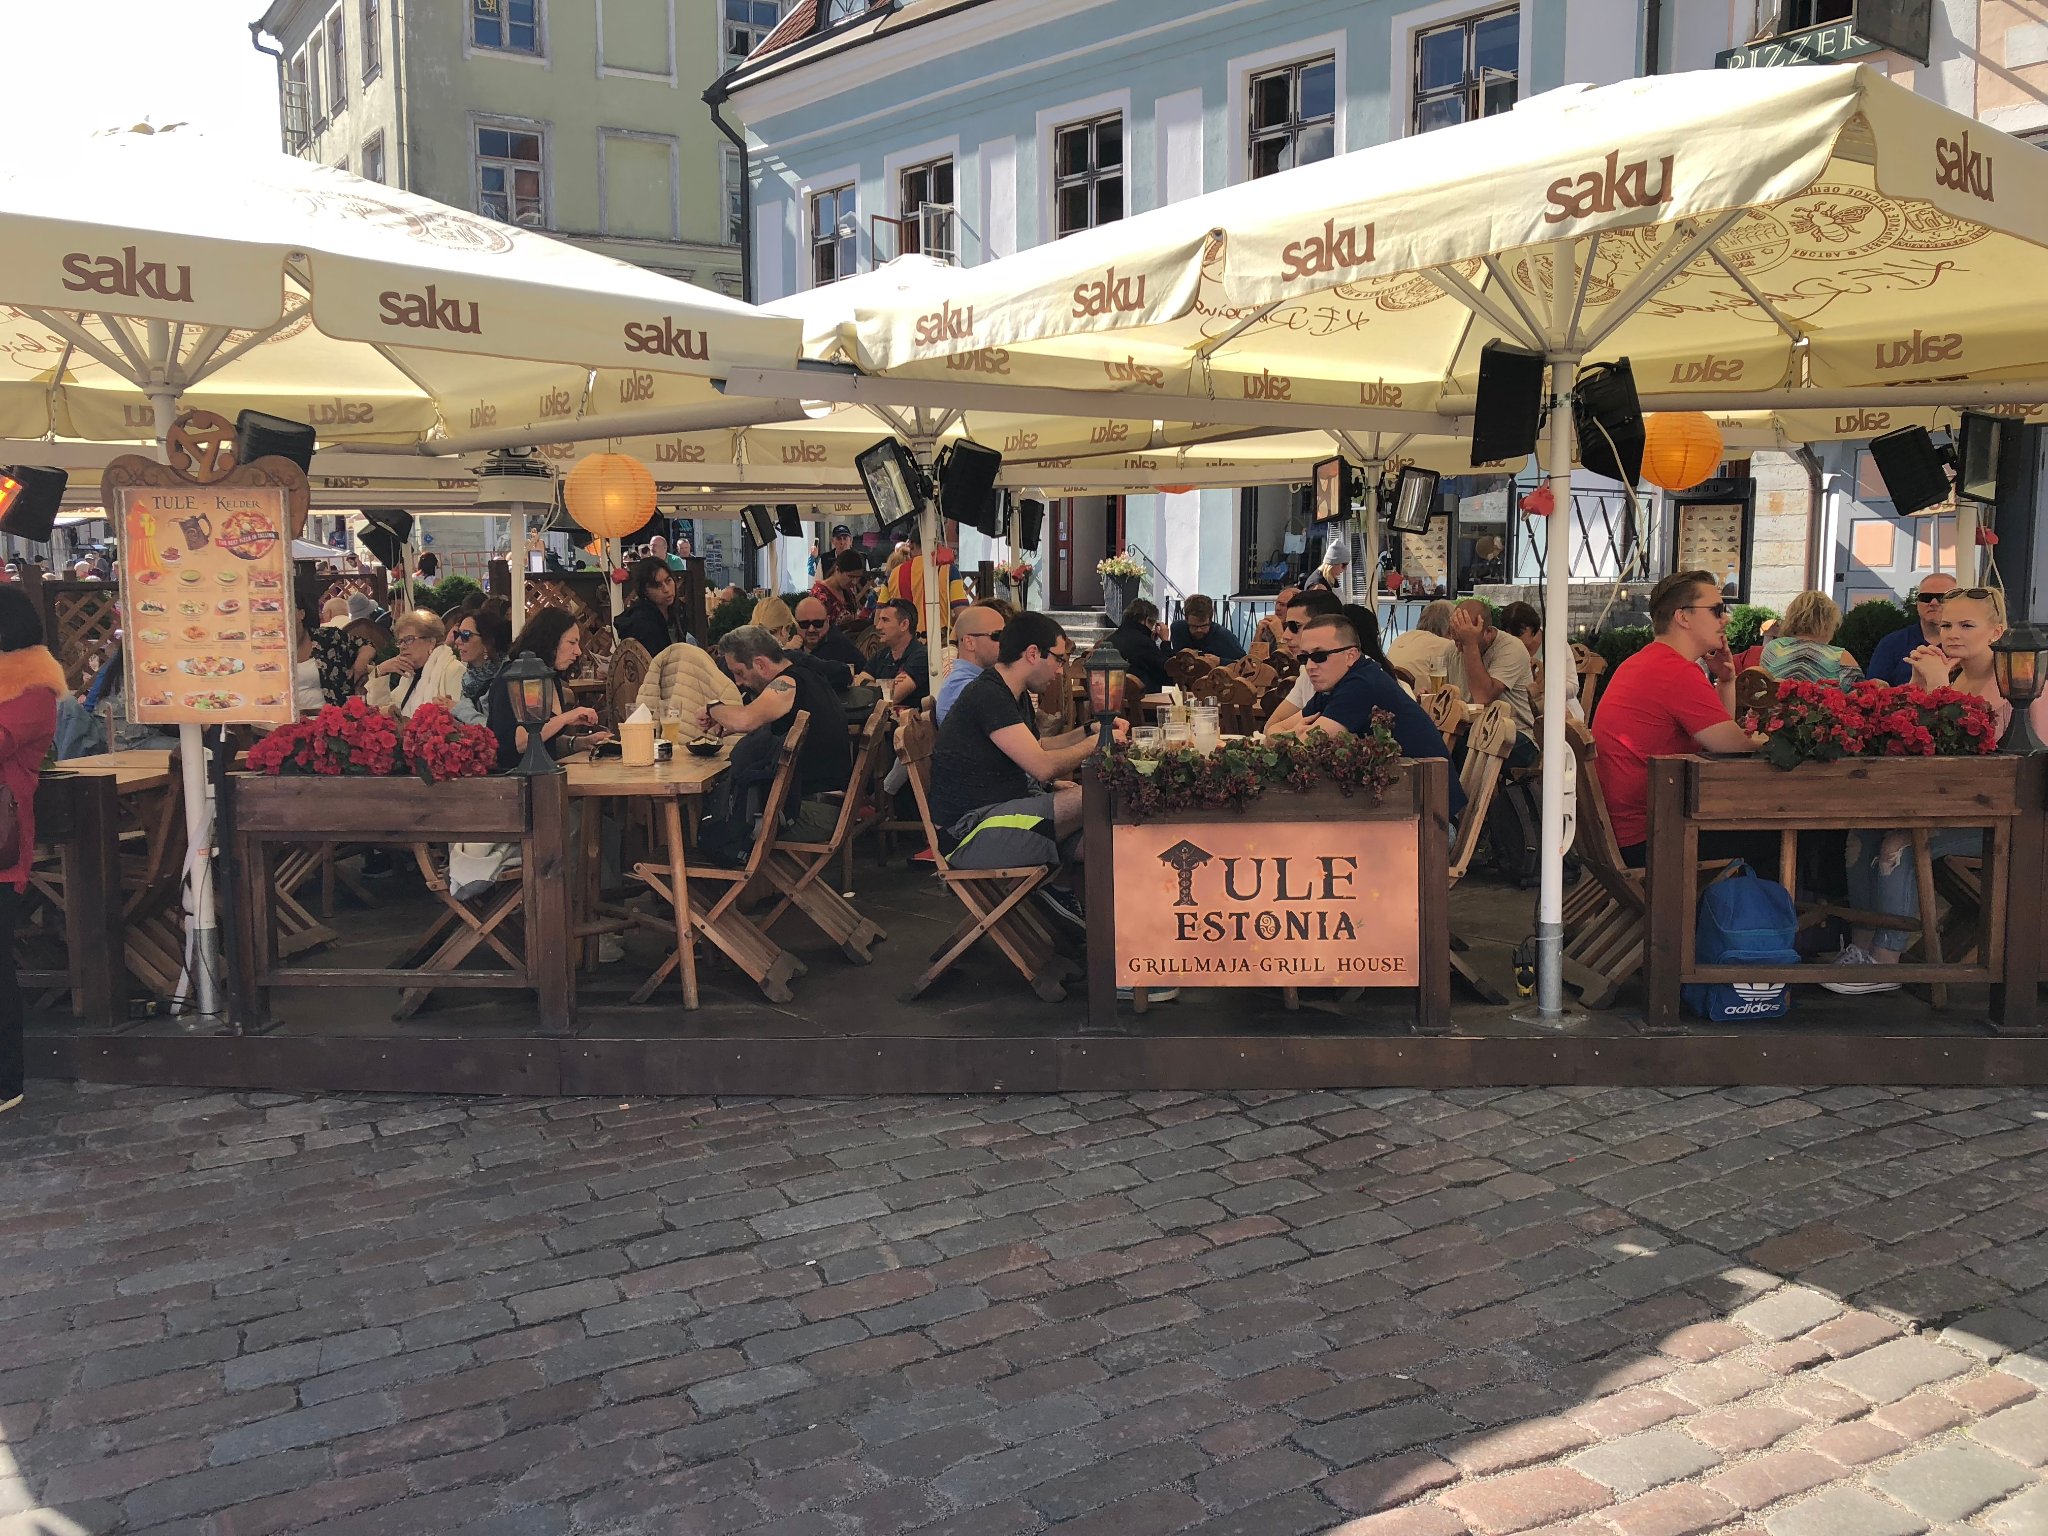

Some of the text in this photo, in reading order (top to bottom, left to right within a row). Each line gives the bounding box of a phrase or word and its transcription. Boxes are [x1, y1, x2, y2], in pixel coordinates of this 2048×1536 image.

[1543, 149, 1675, 224] saku
[1935, 130, 1995, 203] saku
[62, 246, 194, 303] saku
[1281, 218, 1376, 283] saku
[378, 284, 482, 335] saku
[1071, 266, 1146, 318] saku
[623, 316, 710, 361] saku
[915, 299, 974, 347] saku
[152, 496, 199, 510] TULE
[1173, 910, 1358, 942] ESTONIA
[1336, 956, 1408, 973] HOUSE
[1724, 1002, 1781, 1015] adidas
